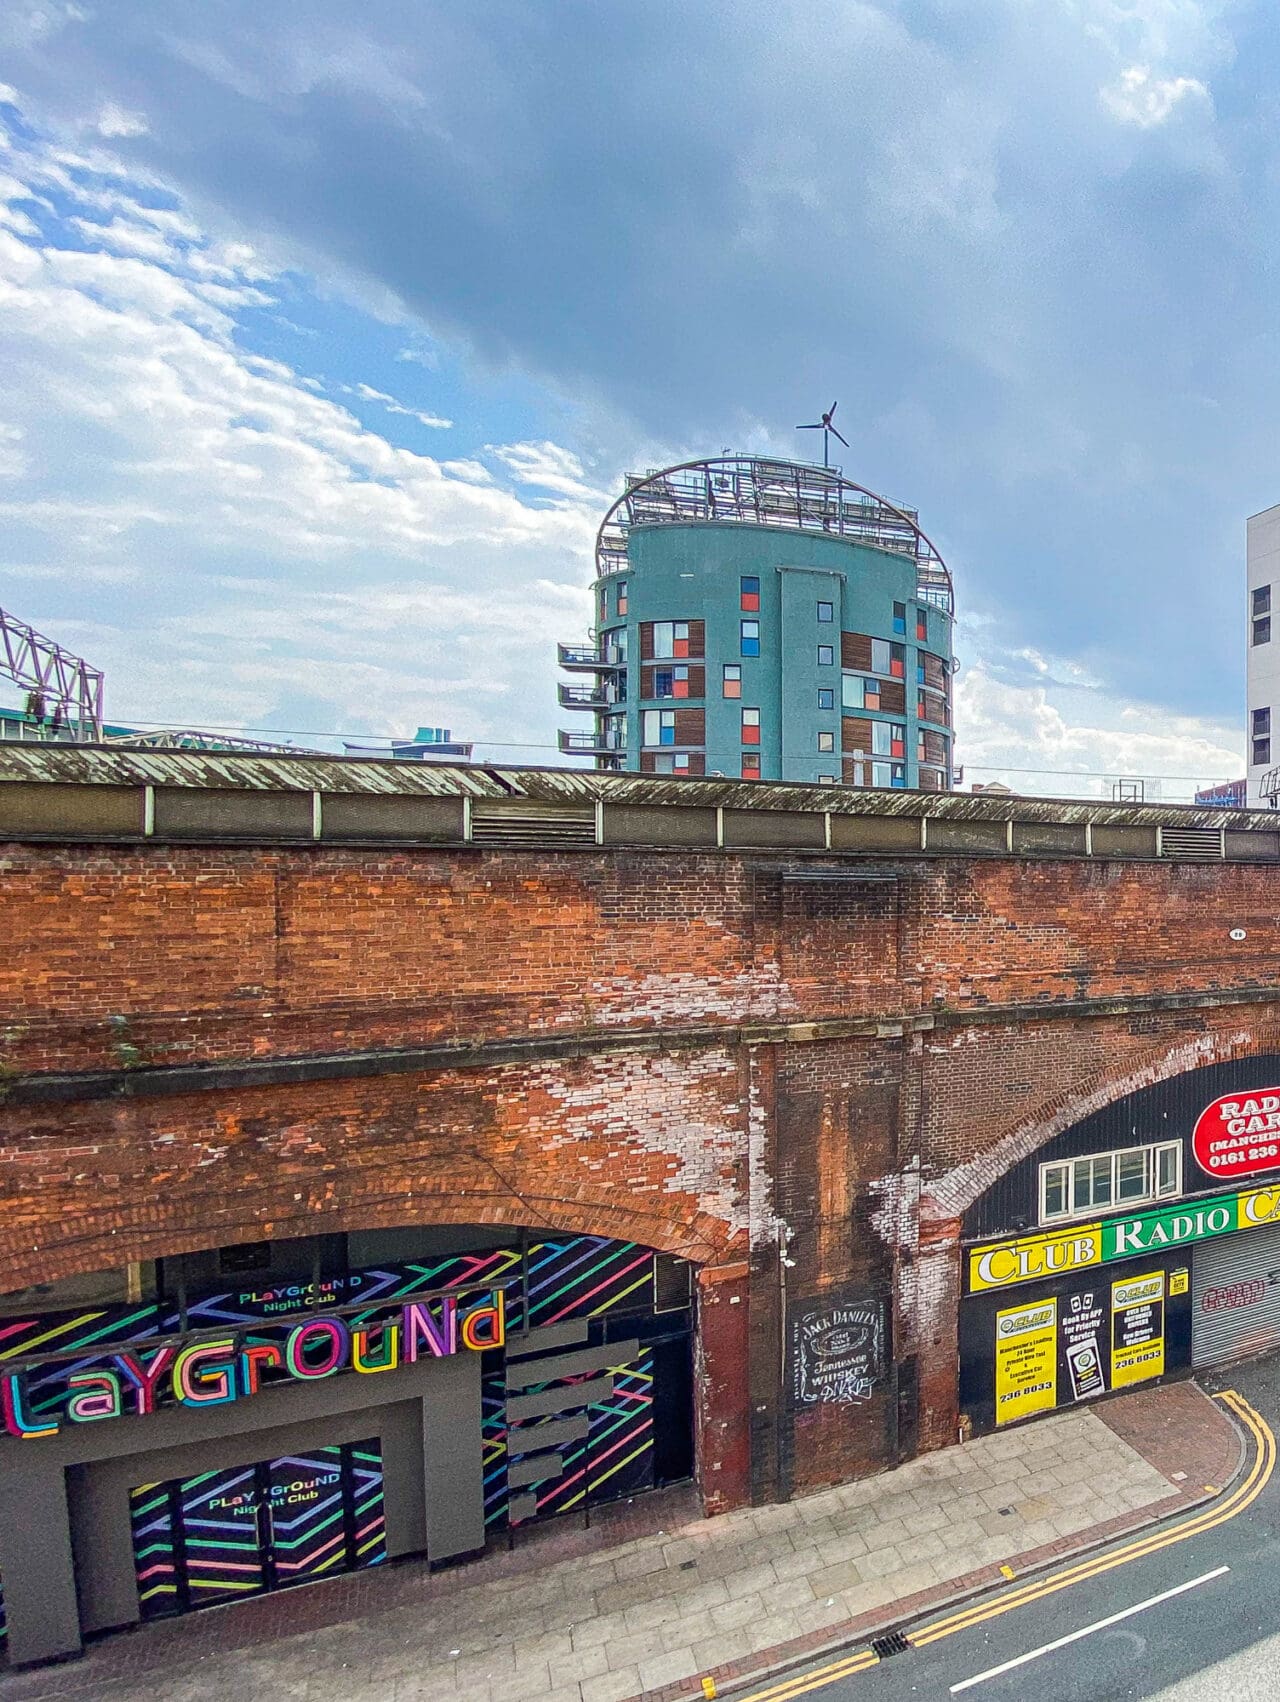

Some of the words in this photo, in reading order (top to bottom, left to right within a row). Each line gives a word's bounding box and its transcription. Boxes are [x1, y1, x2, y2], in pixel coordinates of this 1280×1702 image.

[1209, 1151, 1246, 1168] 0161
[1248, 1145, 1278, 1160] 236
[978, 1237, 1096, 1285] CLUB
[1111, 1207, 1231, 1256] RADIO
[1127, 1282, 1160, 1298] CLUB
[264, 1299, 301, 1312] Night
[304, 1293, 336, 1305] Cub
[1014, 1310, 1052, 1327] CLUB
[803, 1318, 832, 1340] JACK
[1070, 1330, 1095, 1343] Service
[1115, 1357, 1134, 1369] 236
[1000, 1389, 1021, 1403] 236
[1024, 1381, 1052, 1394] 8033
[287, 1491, 319, 1503] Club
